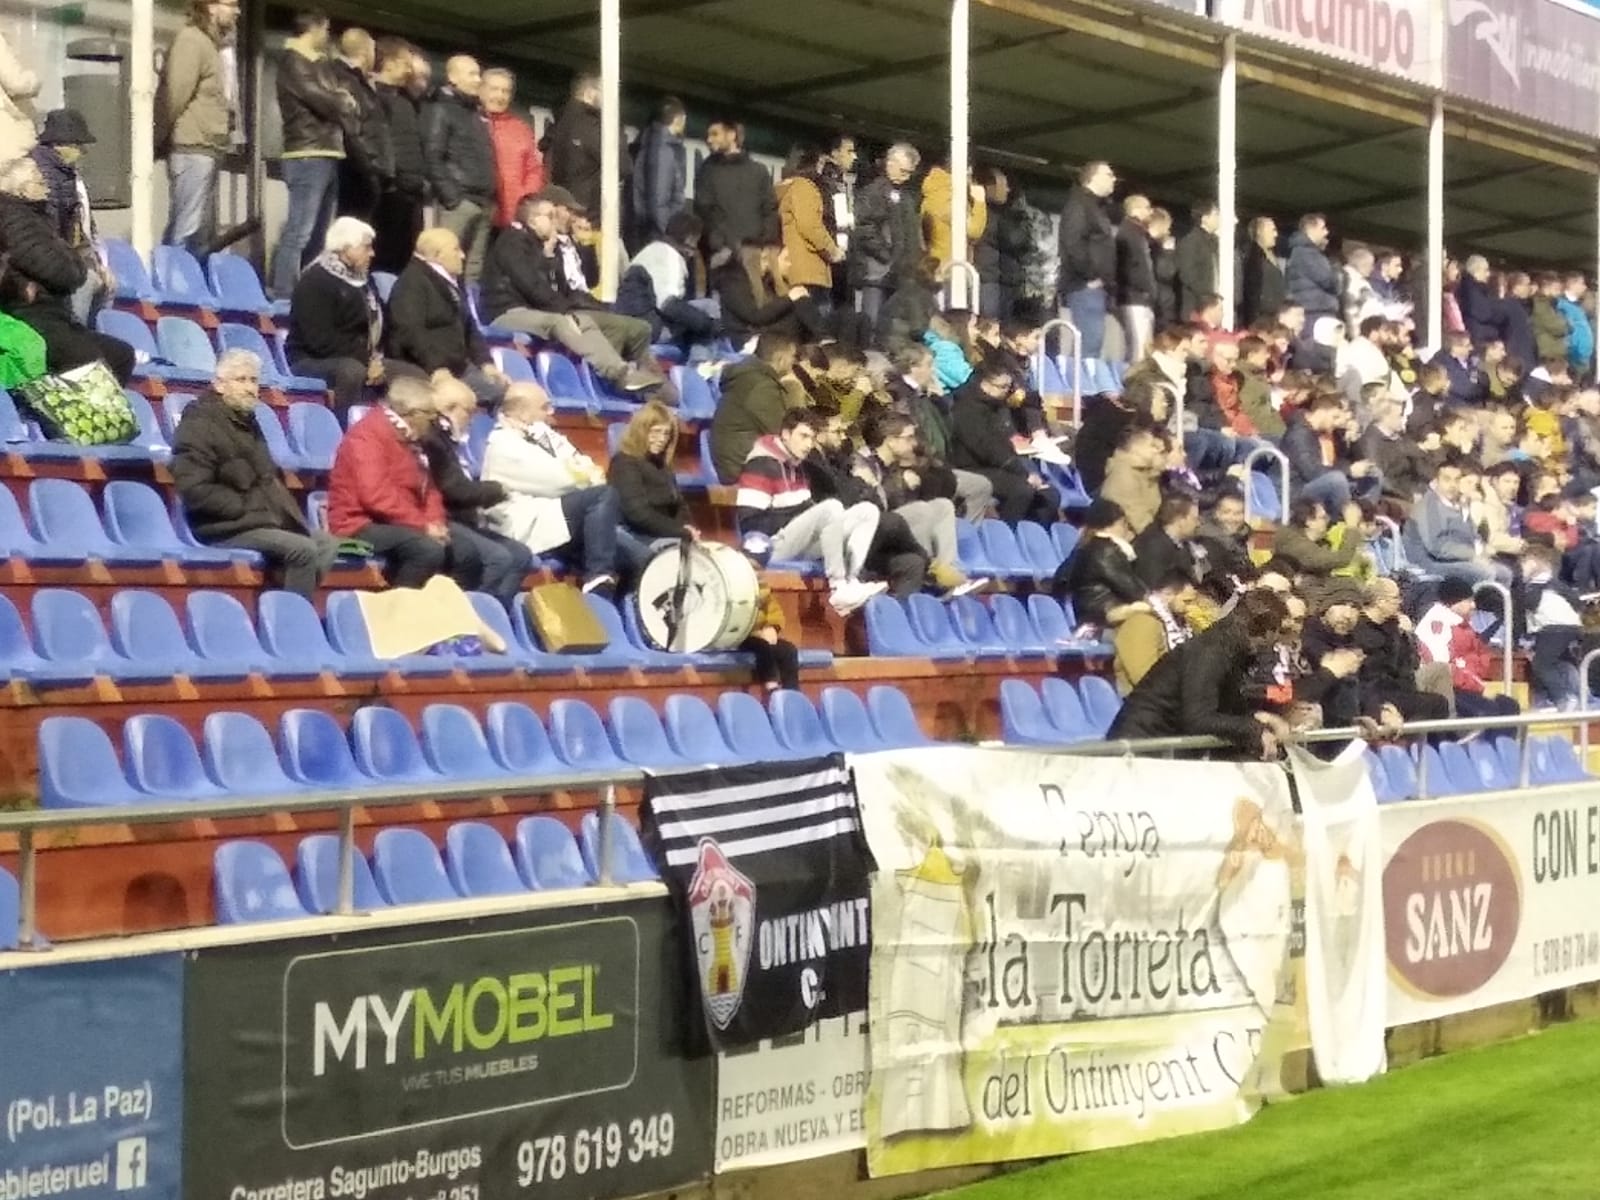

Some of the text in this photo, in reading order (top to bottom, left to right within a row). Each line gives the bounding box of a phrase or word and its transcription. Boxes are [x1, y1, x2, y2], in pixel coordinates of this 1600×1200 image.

[1243, 0, 1415, 71] campo
[1533, 810, 1577, 883] CON
[1587, 805, 1600, 875] E
[986, 890, 1032, 1008] la
[1050, 893, 1222, 1005] Torreta
[1406, 882, 1493, 963] SANZ
[313, 963, 614, 1077] MYMOBEL
[464, 1054, 540, 1082] MUEBLES
[722, 1079, 817, 1122] REFORMAS
[982, 1048, 1031, 1120] del
[1044, 1046, 1211, 1119] Ontinyent
[7, 1079, 153, 1143] (Pol. La Paz)
[720, 1130, 769, 1160] OBRA
[774, 1116, 830, 1148] NUEVA
[835, 1112, 844, 1135] Y
[329, 1146, 482, 1199] Sagunto-Burgos
[517, 1111, 675, 1188] 978 619 349
